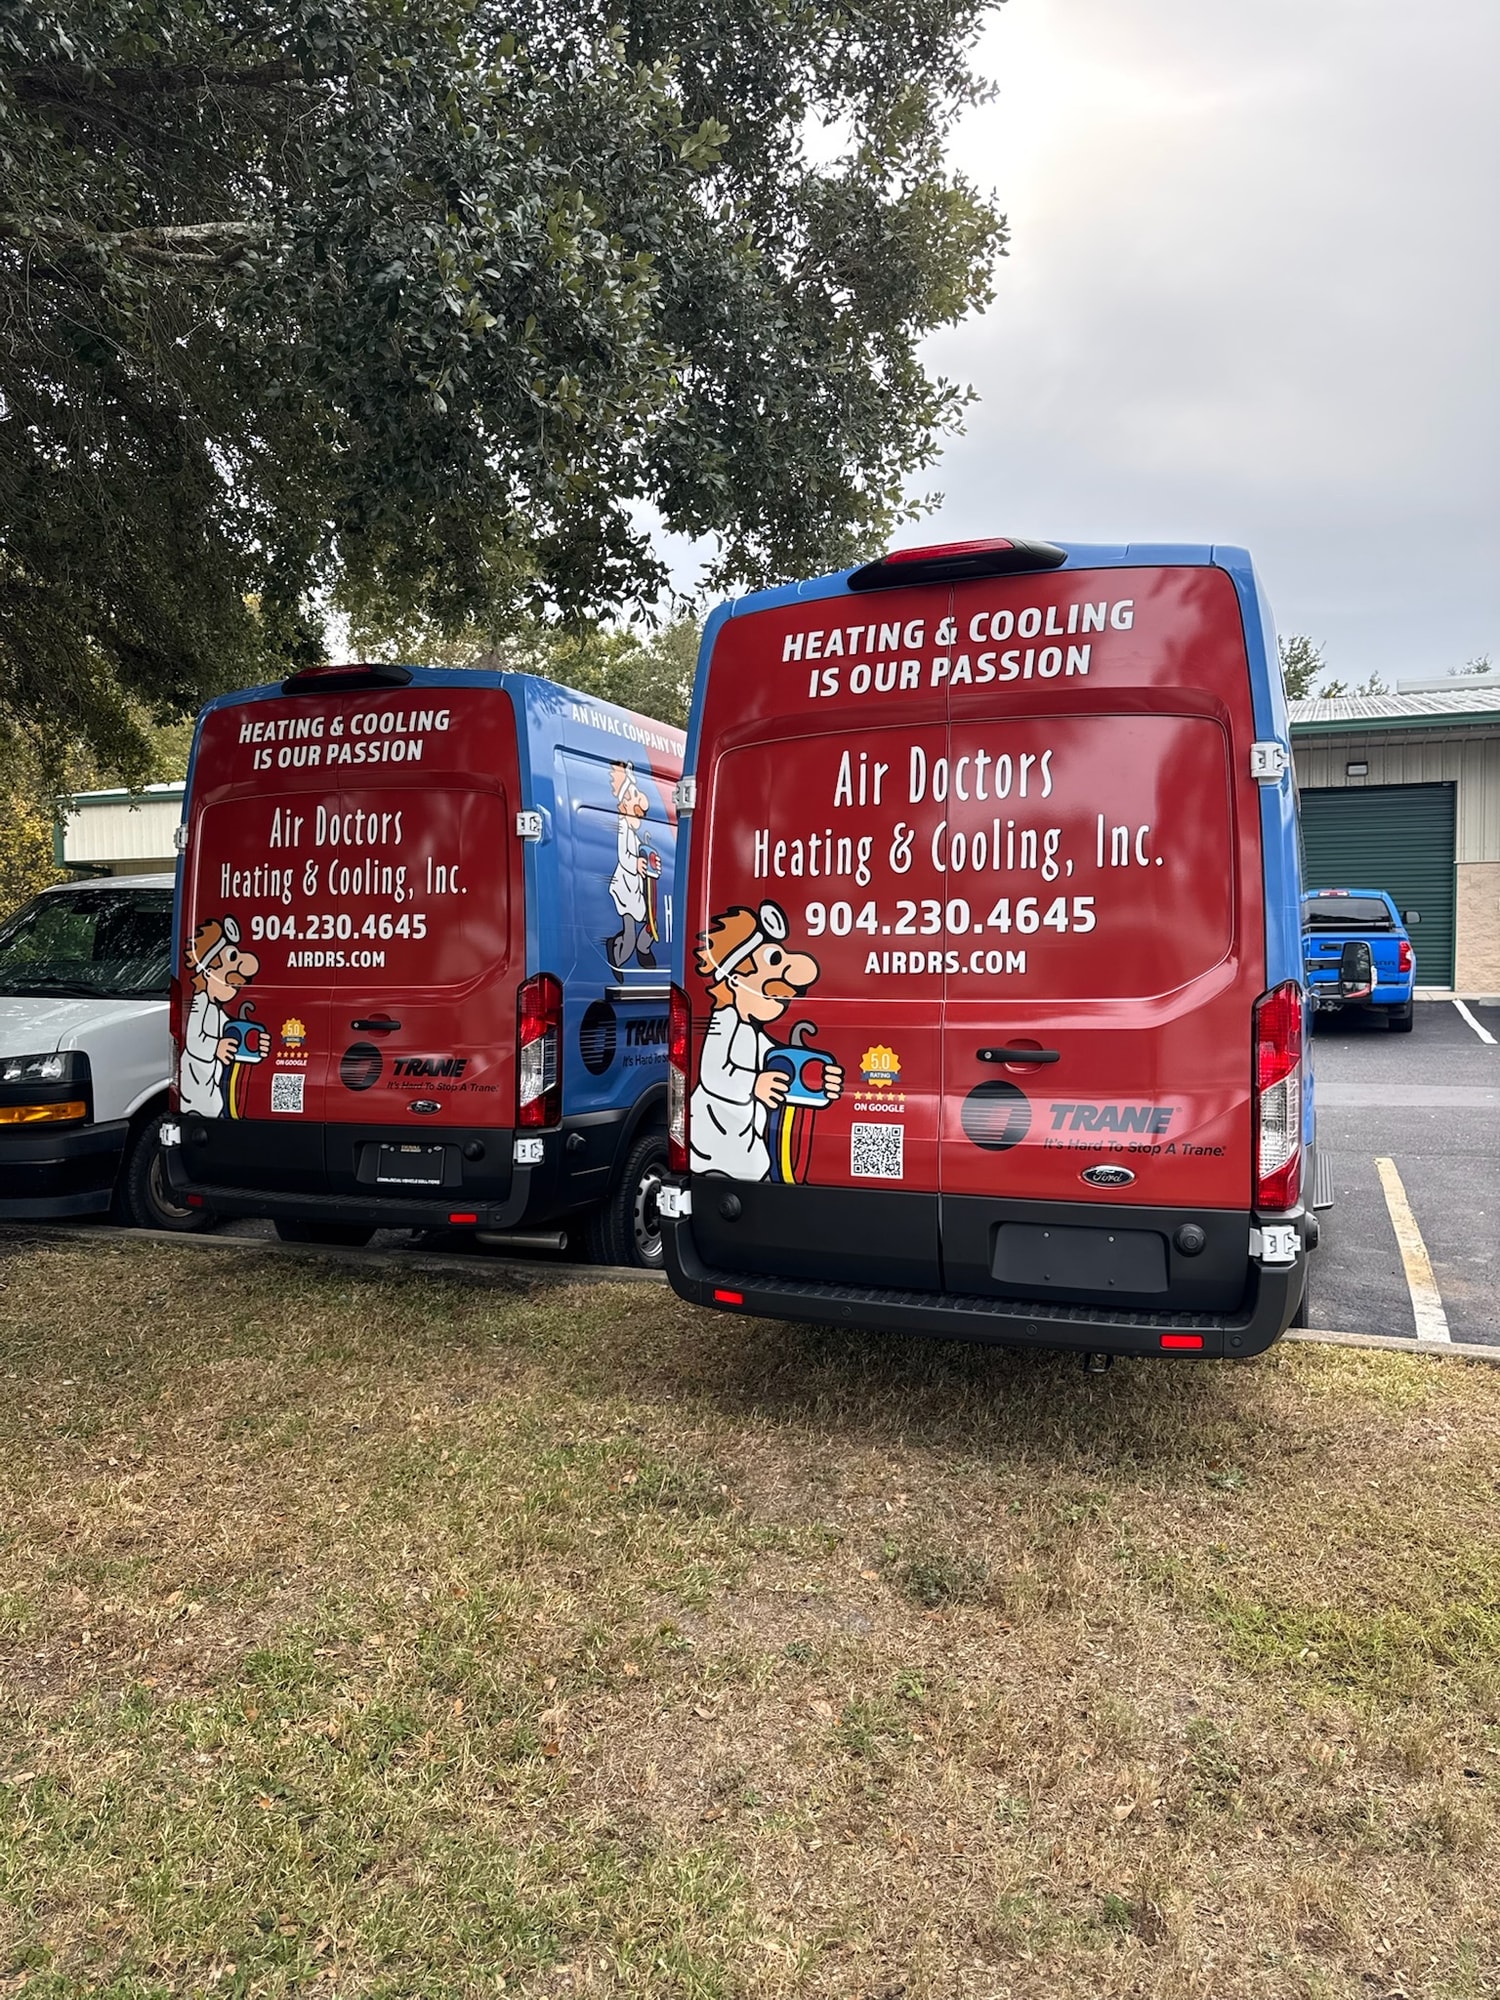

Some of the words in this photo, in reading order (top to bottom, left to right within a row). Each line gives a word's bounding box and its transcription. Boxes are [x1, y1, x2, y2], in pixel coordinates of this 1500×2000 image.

[781, 618, 925, 663] HEATING
[934, 616, 958, 646] &
[969, 599, 1134, 642] COOLING
[808, 667, 839, 698] IS
[849, 658, 920, 694] OUR
[930, 644, 1092, 688] PASSION
[238, 716, 325, 744] HEATING
[331, 716, 344, 737] &
[350, 709, 450, 735] COOLING
[572, 703, 589, 726] AN
[591, 711, 621, 737] HVAC
[622, 722, 671, 755] COMPANY
[253, 749, 273, 770] IS
[278, 745, 321, 768] OUR
[326, 739, 424, 765] PASSION
[833, 749, 889, 807] Air
[909, 745, 1054, 803] Doctors
[269, 807, 304, 848] Air
[315, 805, 403, 847] Doctors
[754, 828, 874, 887] Heating
[889, 822, 915, 874] &
[931, 817, 1074, 882] Cooling,
[1096, 813, 1164, 868] Inc.
[220, 862, 294, 905] Heating
[302, 859, 319, 897] &
[328, 858, 415, 903] Cooling,
[427, 856, 468, 895] Inc.
[250, 913, 428, 941] 904.230.4645
[805, 896, 1097, 937] 904.230.4645
[287, 950, 386, 968] AIRDRS.COM
[864, 950, 1027, 975] AIRDRS.COM
[393, 1058, 467, 1077] TRANE
[870, 1053, 890, 1070] 5.0
[387, 1081, 400, 1090] It's
[400, 1082, 424, 1091] Hard
[425, 1082, 435, 1091] To
[436, 1082, 458, 1092] Stop
[459, 1084, 467, 1092] A
[854, 1102, 868, 1112] ON
[868, 1103, 905, 1113] GOOGLE
[1049, 1103, 1174, 1134] TRANE
[1043, 1138, 1064, 1150] It's
[1068, 1139, 1103, 1152] Hard
[1108, 1140, 1124, 1153] To
[1128, 1141, 1162, 1156] Stop
[1165, 1143, 1176, 1154] A
[1092, 1167, 1123, 1183] Ford
